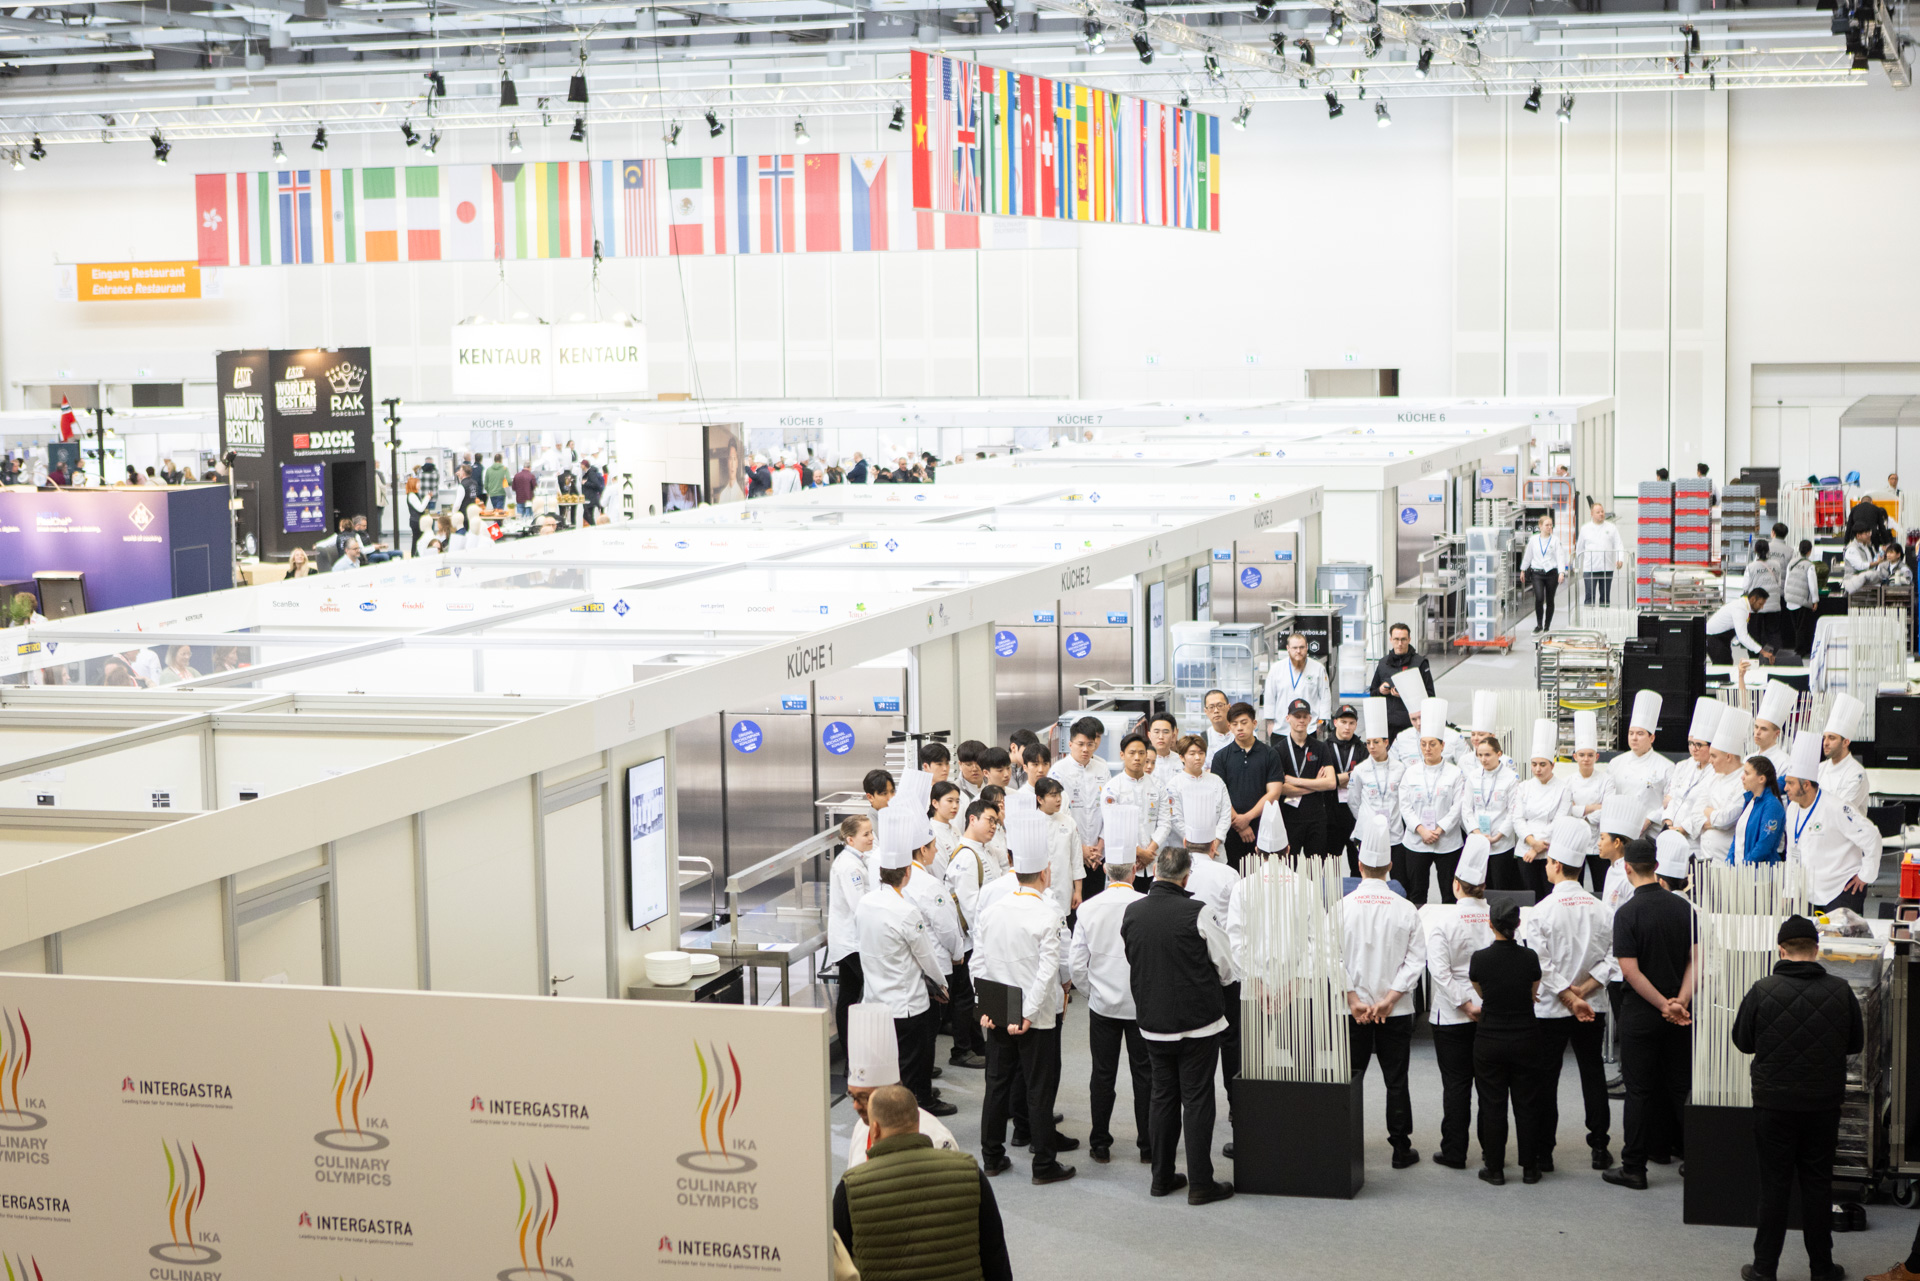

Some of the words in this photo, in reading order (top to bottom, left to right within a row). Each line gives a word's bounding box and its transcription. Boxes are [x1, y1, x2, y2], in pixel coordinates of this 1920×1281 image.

[91, 268, 130, 281] Eingang
[132, 267, 185, 278] Restaurant
[92, 284, 133, 295] Entrance
[135, 283, 186, 293] Restaurant
[459, 348, 541, 365] KENTAUR
[559, 346, 638, 363] KENTAUR
[275, 382, 316, 396] WORLD'S
[224, 397, 264, 421] WORLD'S
[276, 395, 299, 409] BEST
[299, 394, 317, 408] PAN
[330, 394, 364, 411] RAK
[472, 418, 505, 428] KÜCHE
[508, 420, 514, 429] 9
[779, 417, 813, 427] KÜCHE
[818, 417, 824, 427] 8
[1057, 414, 1092, 425] KÜCHE
[1097, 415, 1103, 425] 7
[1398, 412, 1436, 422] KÜCHE
[1440, 413, 1446, 422] 6
[226, 421, 246, 444] BEST
[247, 421, 265, 444] PAN
[310, 430, 355, 449] DICK
[1062, 567, 1084, 592] KÜCHE
[1086, 566, 1091, 583] 2
[272, 600, 300, 608] ScanBox
[788, 646, 826, 679] KÜCHE
[828, 643, 833, 666] 1
[140, 1080, 232, 1099] INTERGASTRA
[26, 1098, 46, 1109] IKA
[490, 1100, 589, 1119] INTERGASTRA
[366, 1118, 389, 1129] IKA
[0, 1136, 48, 1150] LINARY
[733, 1138, 756, 1150] IKA
[314, 1155, 390, 1172] CULINARY
[315, 1170, 392, 1186] OLYMPICS
[676, 1178, 757, 1194] CULINARY
[0, 1194, 70, 1212] ERGASTRA
[677, 1193, 759, 1210] OLYMPICS
[317, 1216, 413, 1236] INTERGASTRA
[199, 1232, 220, 1243] IKA
[679, 1240, 781, 1261] INTERGASTRA
[550, 1256, 574, 1268] IKA
[150, 1268, 222, 1281] CULINARY
